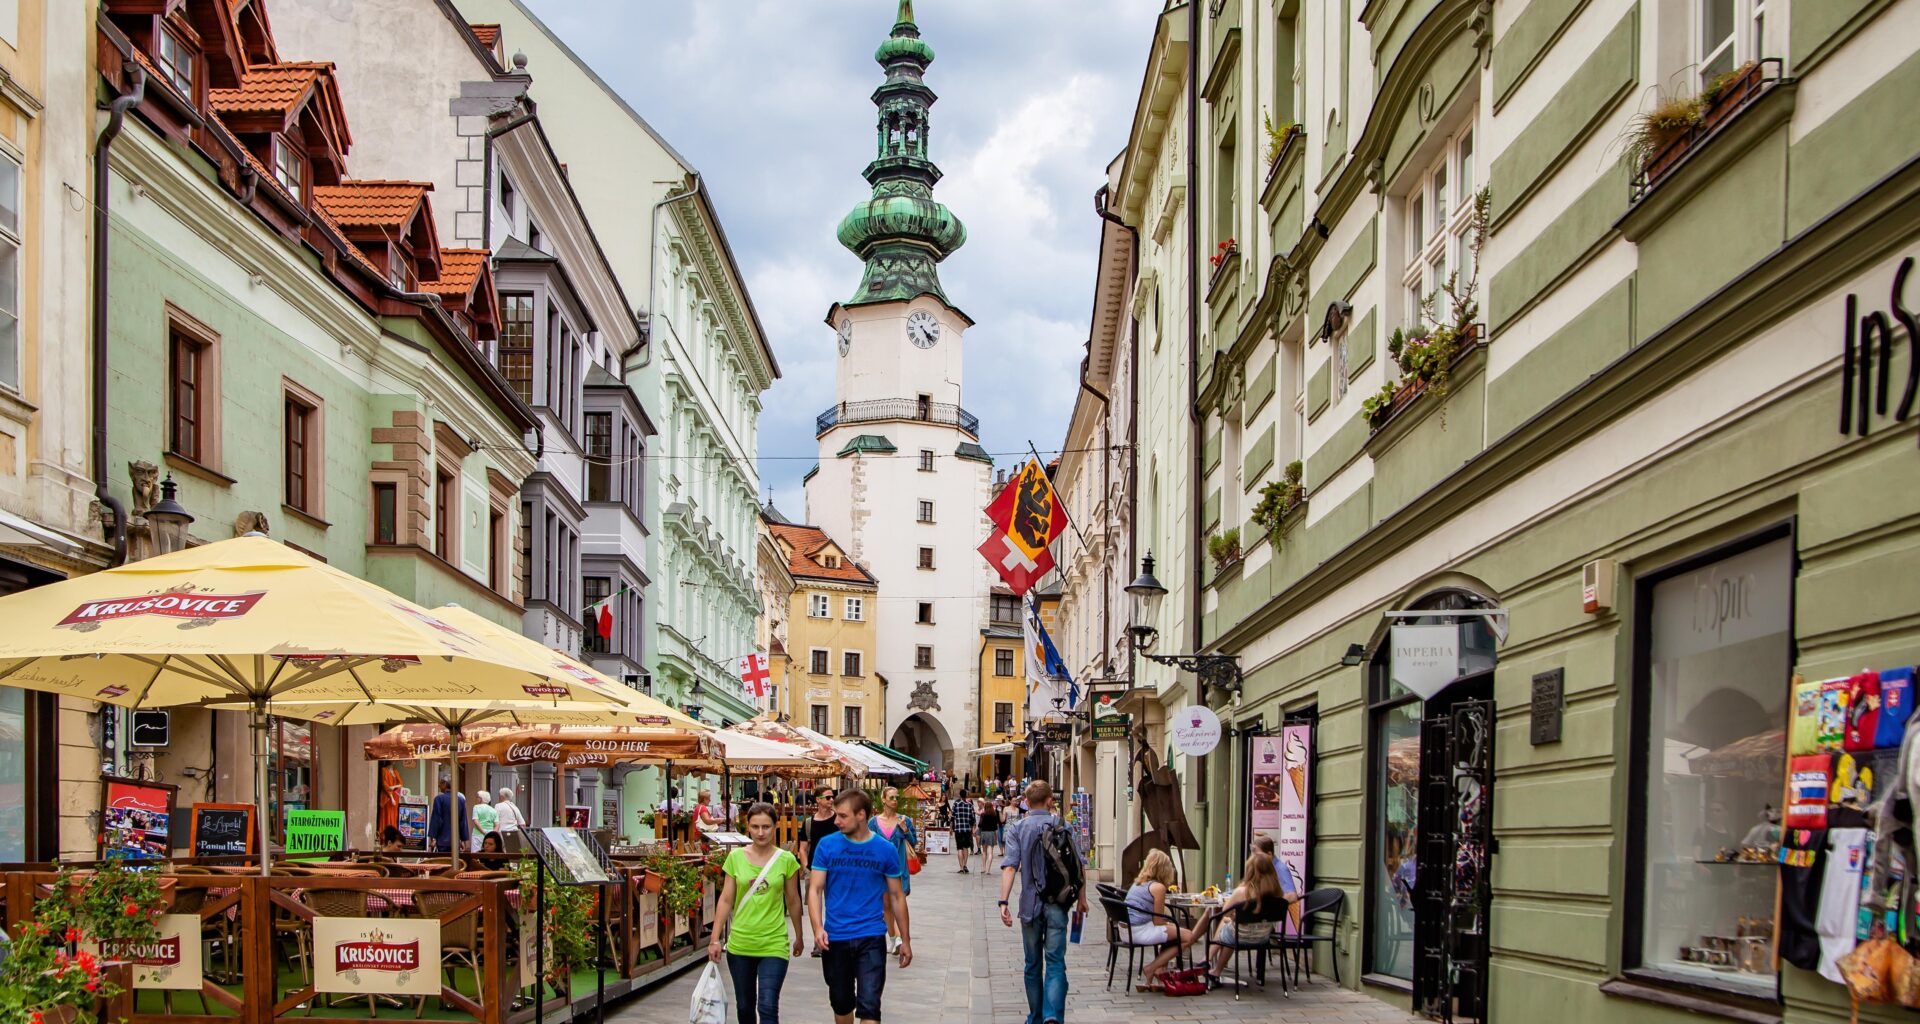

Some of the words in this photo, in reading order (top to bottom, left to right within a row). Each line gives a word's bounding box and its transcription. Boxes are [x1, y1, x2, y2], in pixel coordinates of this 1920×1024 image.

[1840, 256, 1920, 436] InS
[77, 596, 246, 618] KRUŠOVICE
[1396, 647, 1455, 657] IMPERIA
[417, 743, 436, 755] ICE
[506, 741, 562, 762] Coca-Cola
[585, 740, 618, 751] SOLD
[620, 741, 651, 752] HERE
[290, 815, 340, 828] STAROŽITNOSTI
[289, 832, 339, 853] ANTIQUES
[339, 945, 414, 964] KRUŠOVICE
